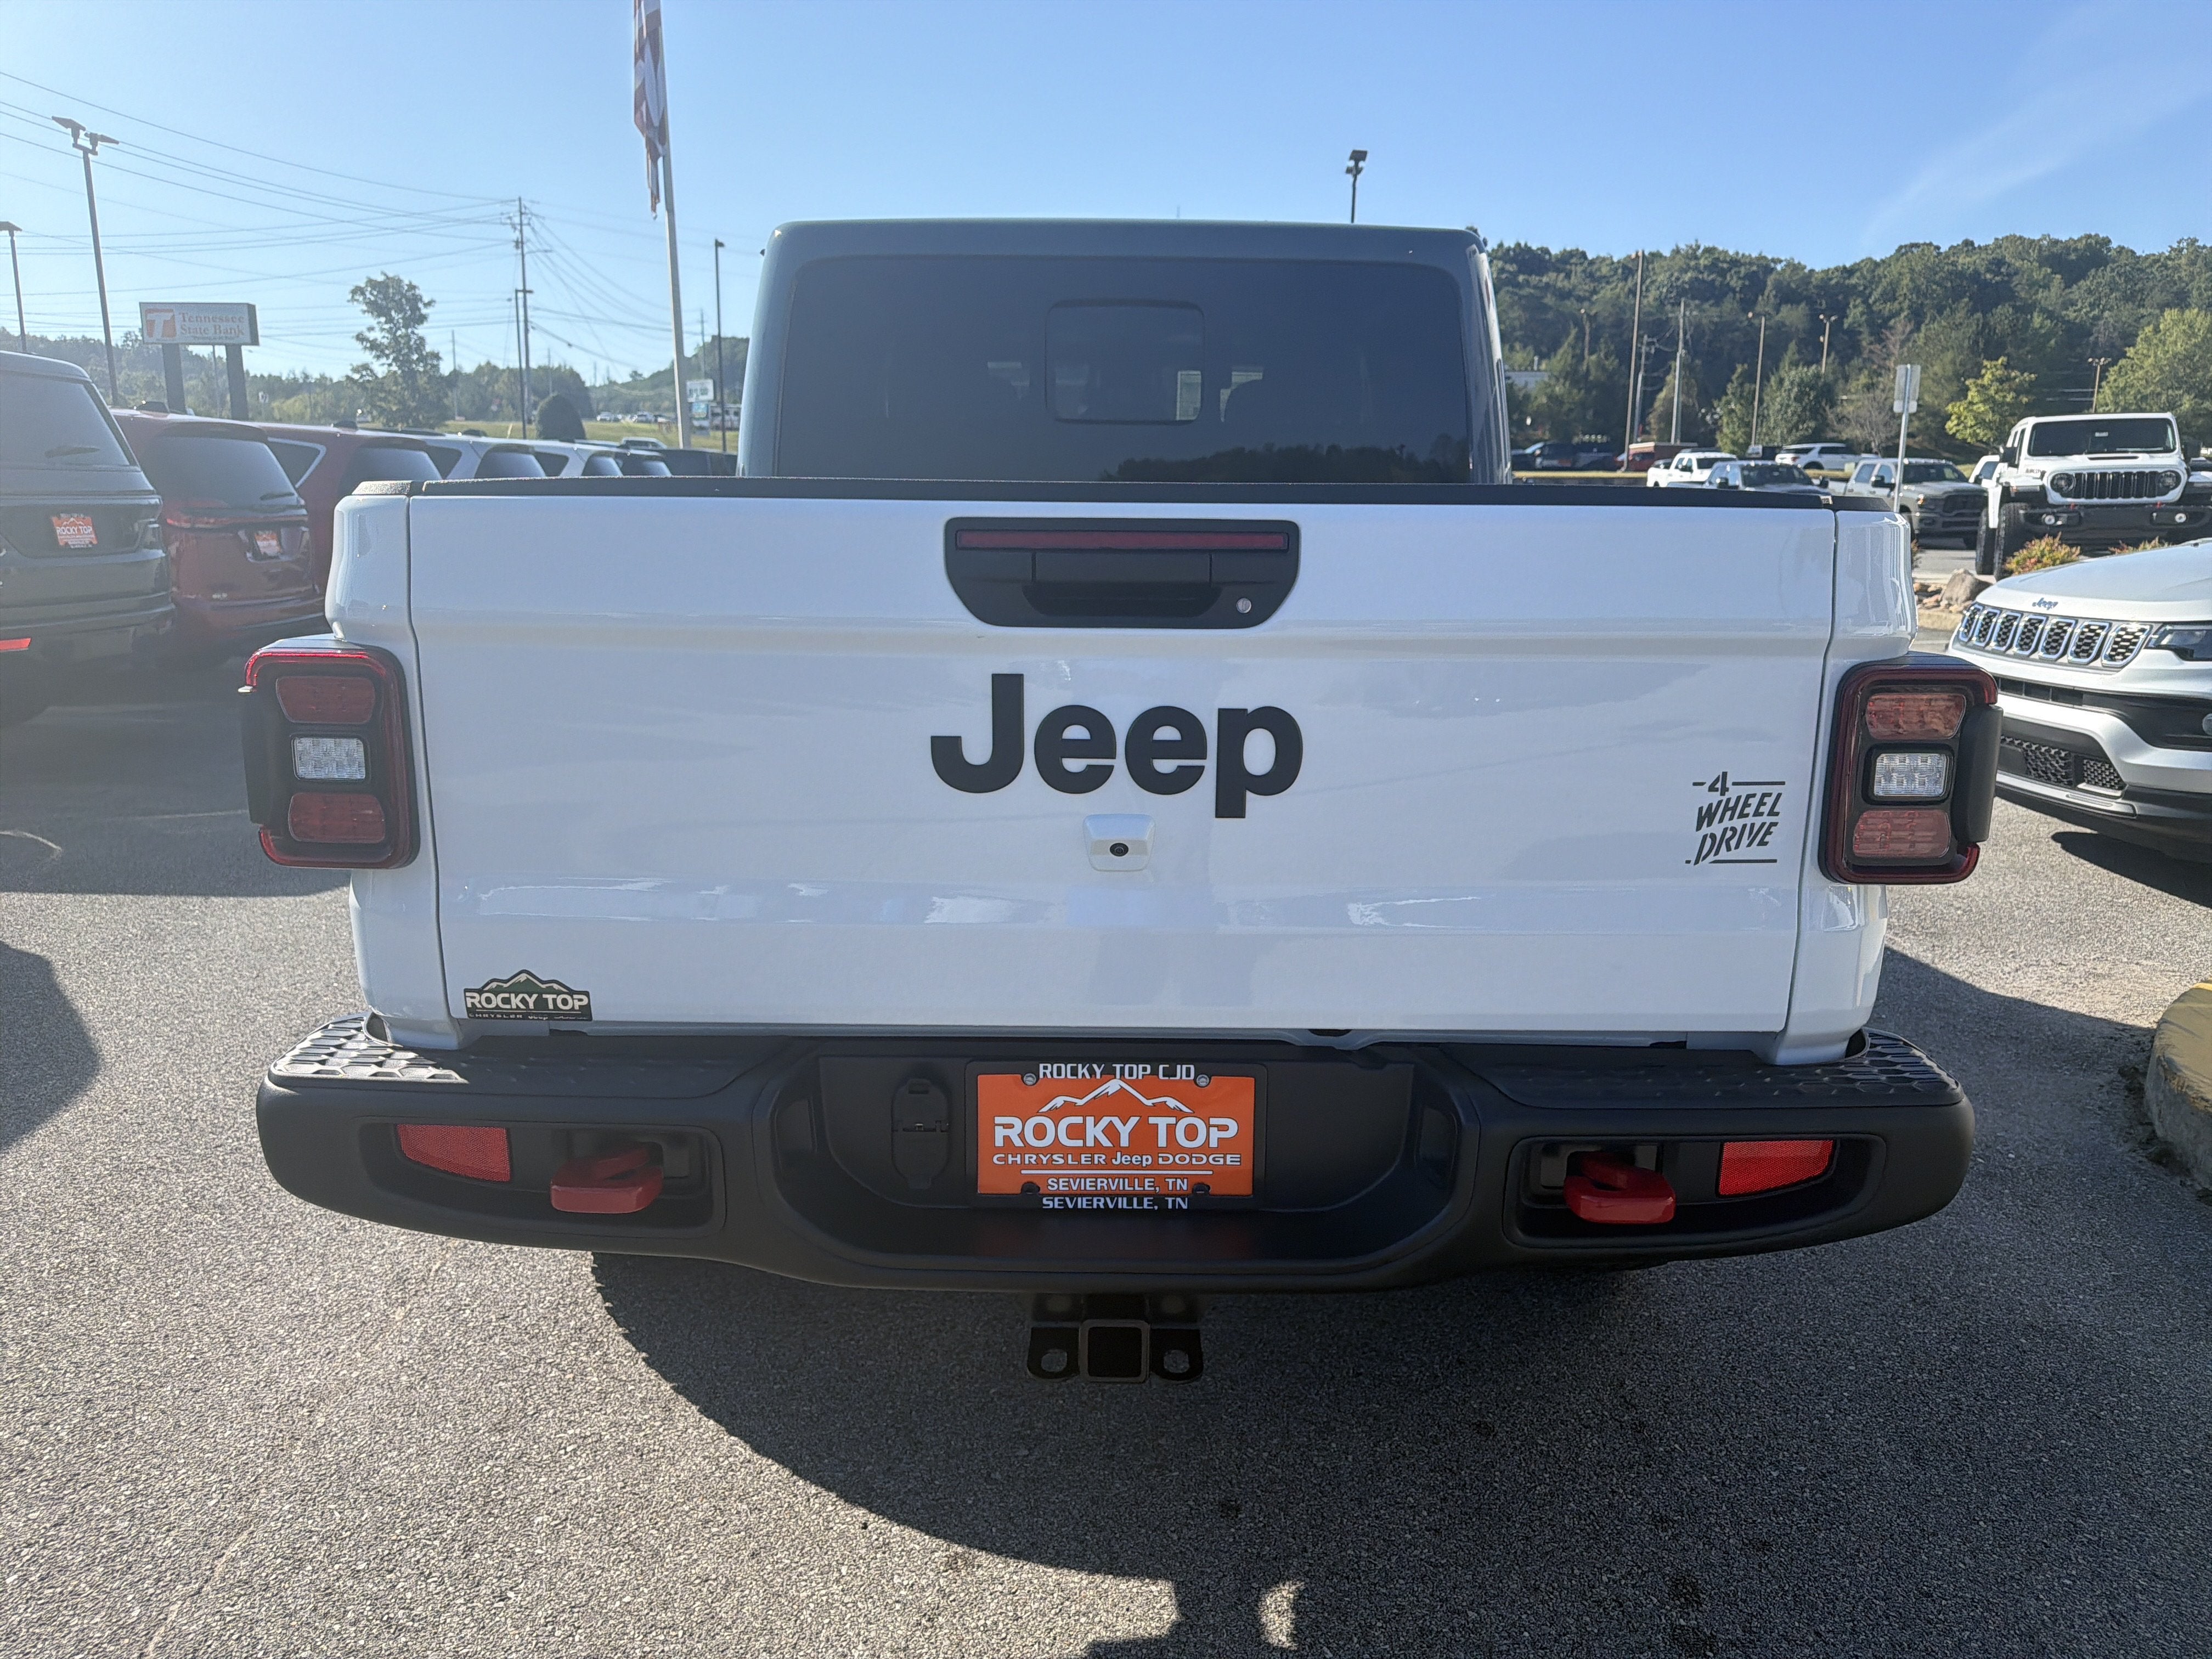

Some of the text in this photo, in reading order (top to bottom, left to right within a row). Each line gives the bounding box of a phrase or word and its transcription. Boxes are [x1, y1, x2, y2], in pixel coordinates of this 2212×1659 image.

[179, 312, 245, 323] Tennessee
[180, 324, 245, 337] State Bank
[56, 526, 92, 534] ROCKY TOP
[2032, 597, 2058, 610] Jeep
[930, 673, 1304, 819] Jeep
[1707, 771, 1730, 796] 4
[1696, 792, 1783, 832] WHEEL
[1693, 822, 1780, 866] DRIVE
[465, 992, 589, 1011] ROCKY TOP
[1039, 1063, 1195, 1081] ROCKY TOP CJD
[994, 1115, 1239, 1148] ROCKY TOP
[992, 1152, 1242, 1167] CHRYSLER Jeep DODGE
[1047, 1177, 1188, 1193] SEVIERVILLE, TN
[1042, 1197, 1188, 1210] SEVIERVILLE, TN
